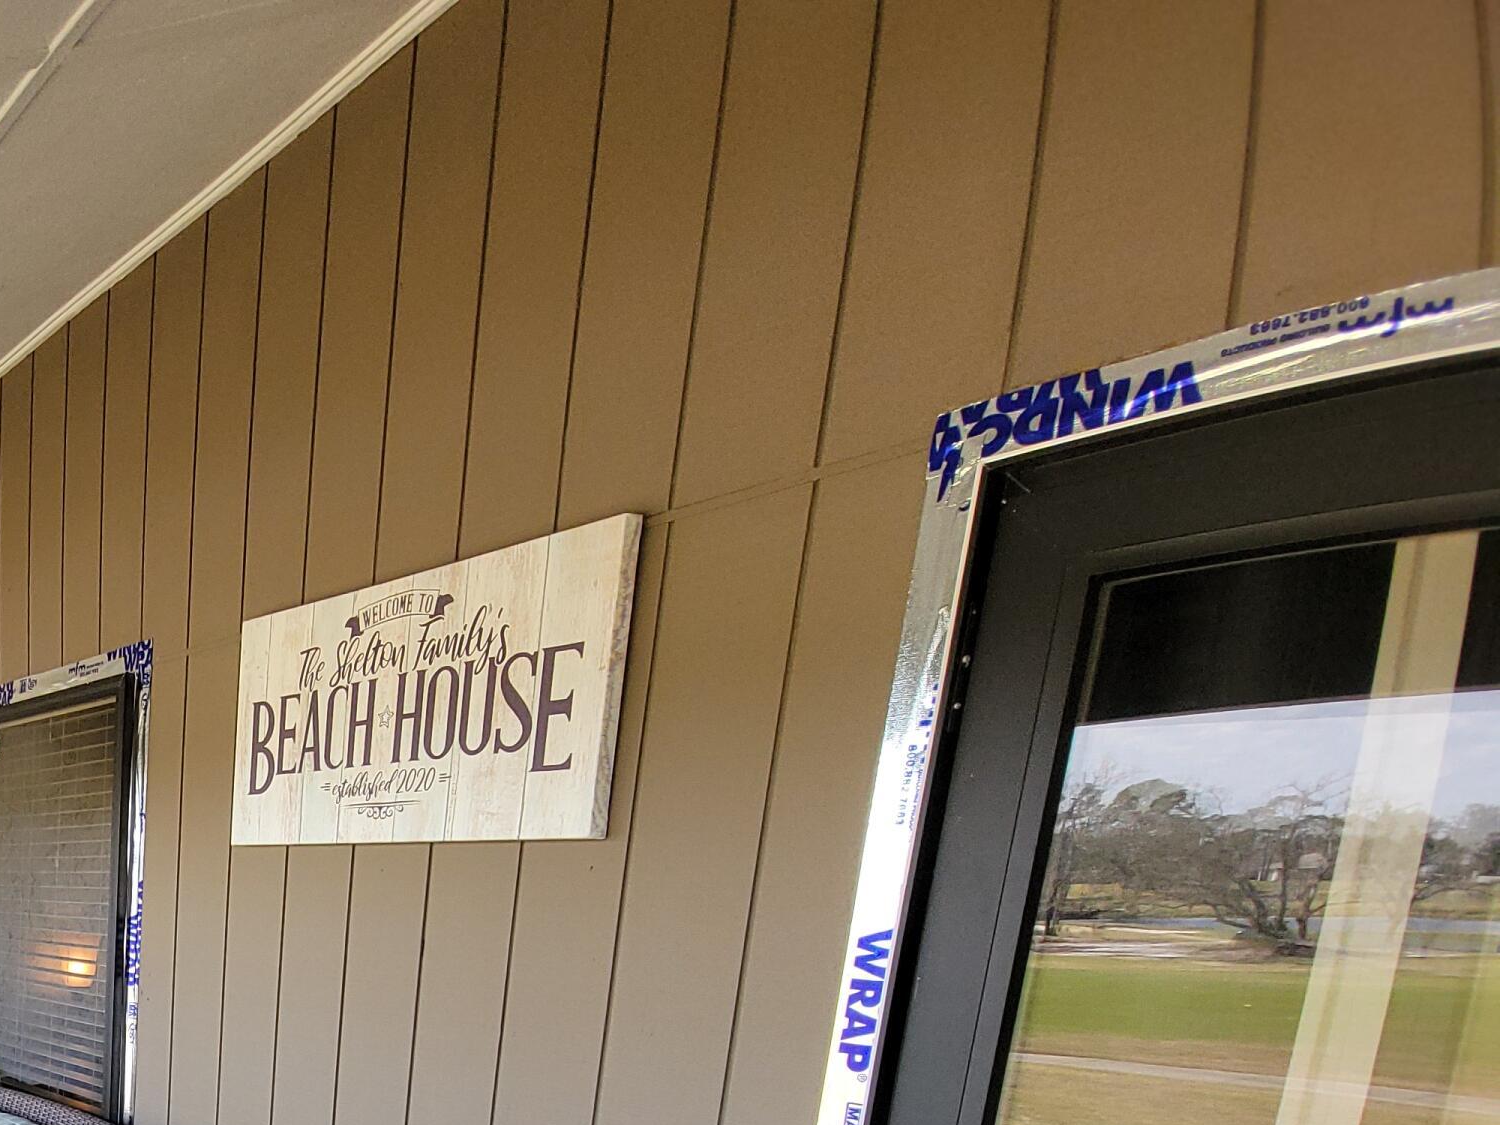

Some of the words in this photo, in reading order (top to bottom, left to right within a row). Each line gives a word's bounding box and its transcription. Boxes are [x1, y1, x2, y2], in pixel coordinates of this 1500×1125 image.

[299, 646, 326, 692] The
[329, 630, 406, 688] Shelton
[412, 604, 510, 675] Family's
[362, 593, 413, 629] WELCOME
[418, 593, 435, 614] TO
[247, 678, 379, 796] BEACH
[390, 641, 586, 774] HOUSE
[332, 769, 399, 804] established
[396, 767, 437, 794] 2020
[838, 928, 895, 1073] WRAP
